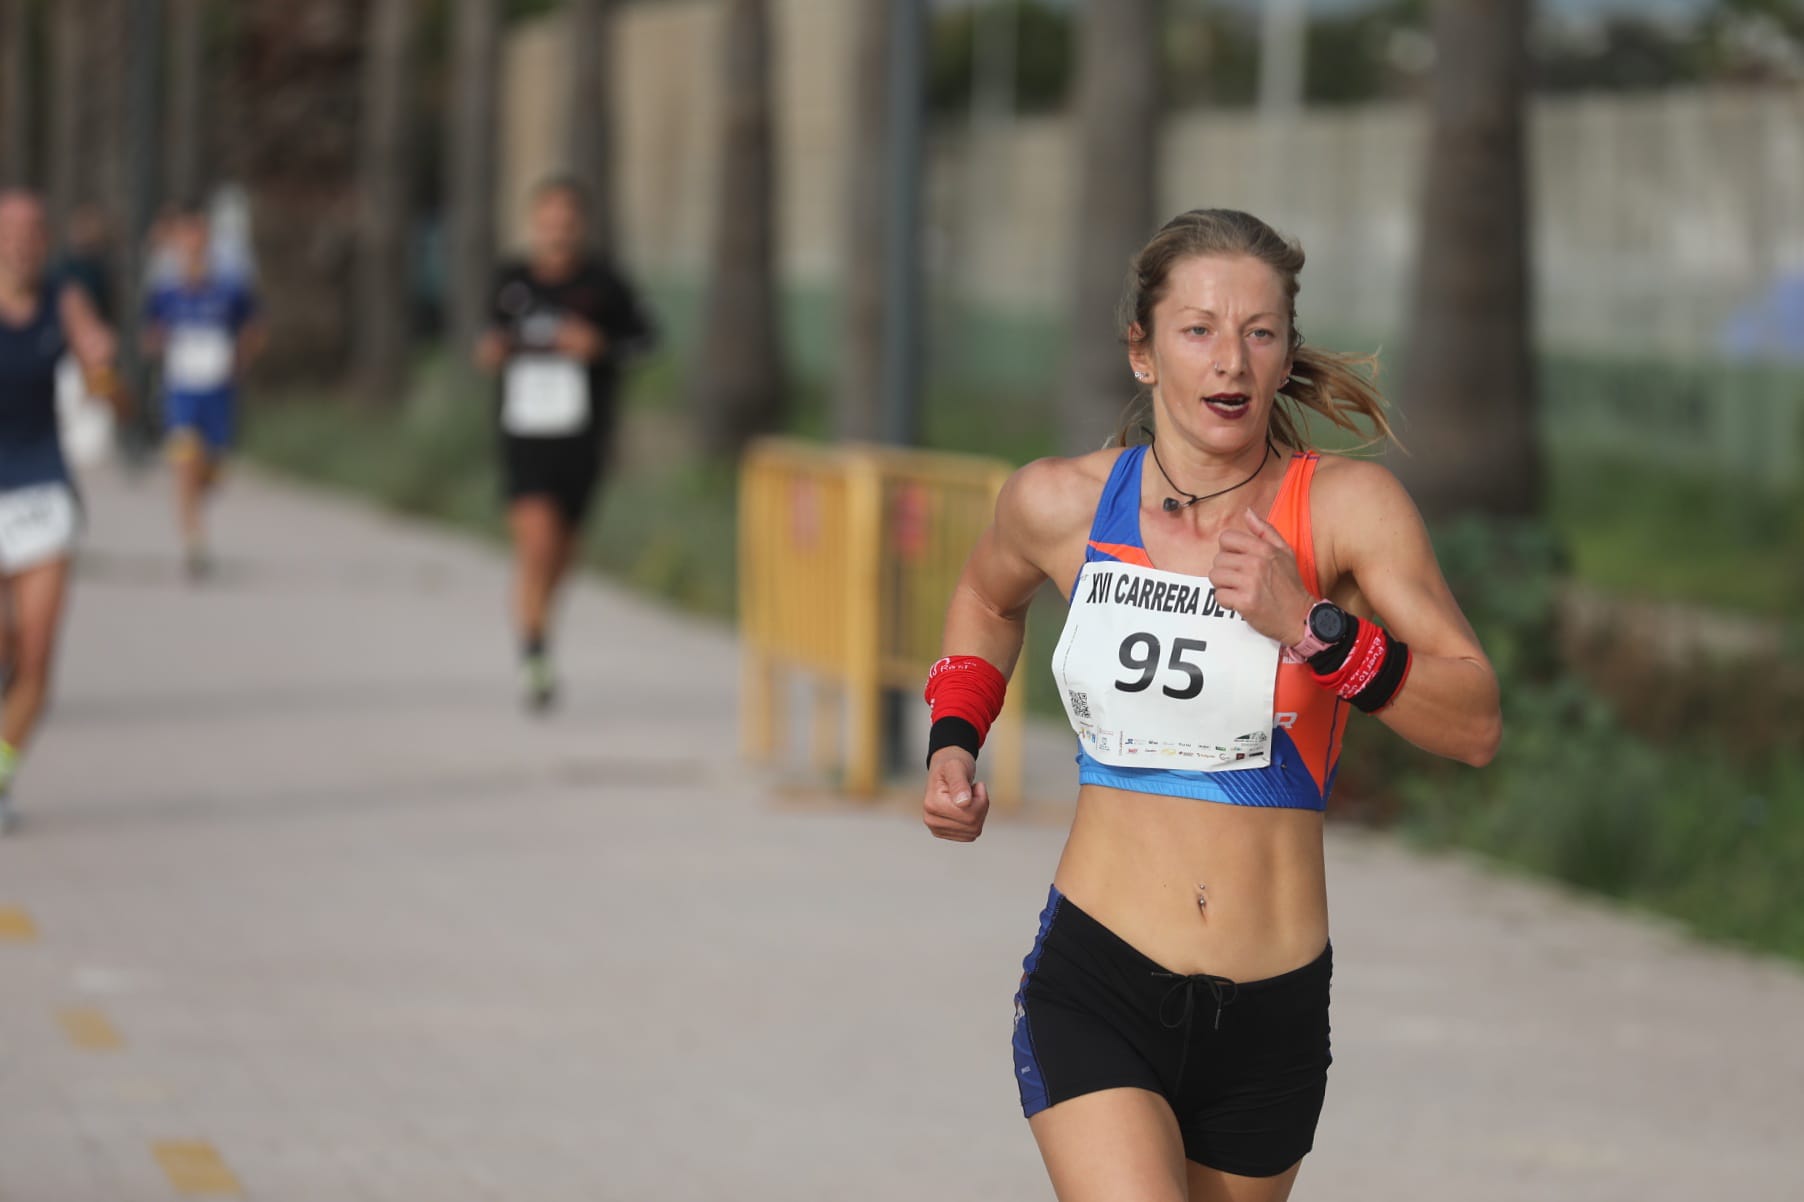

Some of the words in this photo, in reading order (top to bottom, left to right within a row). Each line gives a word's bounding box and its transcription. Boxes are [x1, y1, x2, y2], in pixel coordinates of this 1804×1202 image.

[1086, 572, 1113, 604] XVI
[1114, 574, 1201, 615] CARRERA
[1114, 631, 1207, 700] 95
